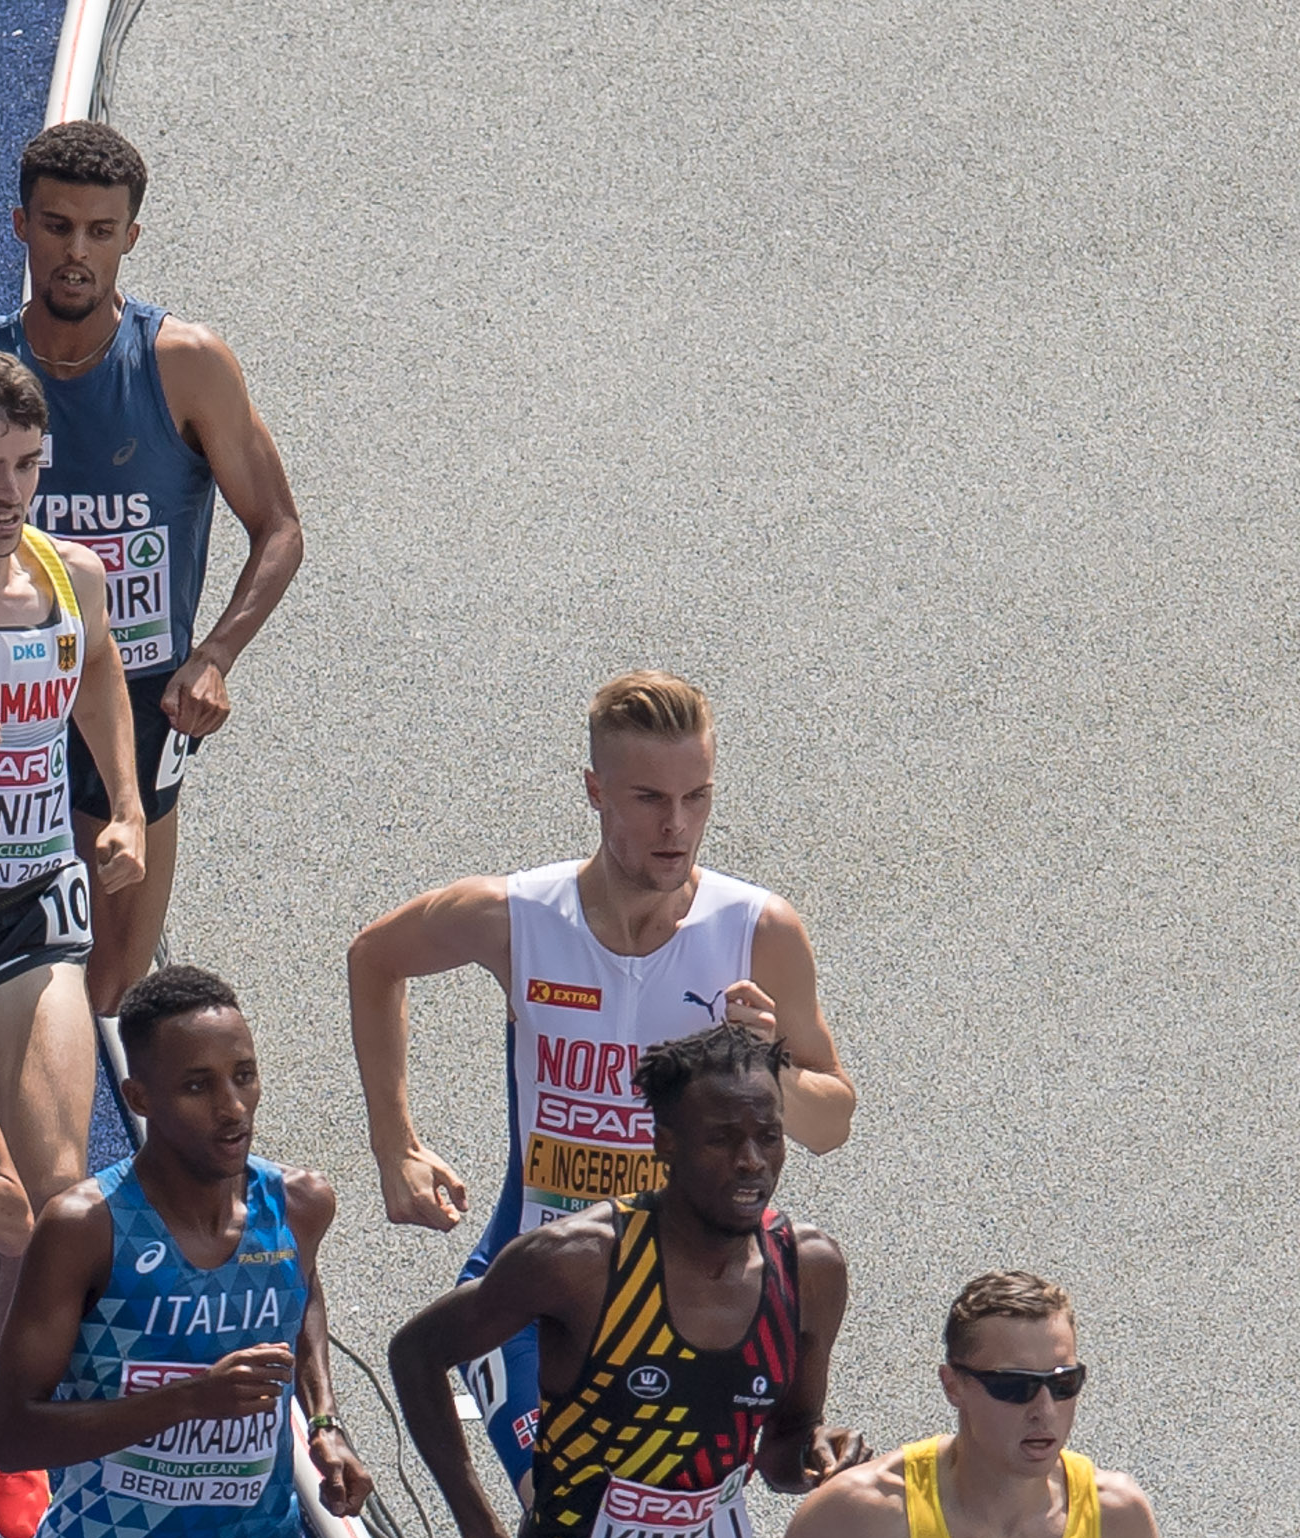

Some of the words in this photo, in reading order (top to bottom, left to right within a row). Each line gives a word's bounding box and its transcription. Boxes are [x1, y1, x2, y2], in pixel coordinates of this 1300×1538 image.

[28, 494, 151, 531] YPRUS
[13, 642, 46, 662] DKB
[120, 641, 159, 665] 018
[43, 877, 89, 936] 10
[553, 989, 598, 1005] EXTRA
[540, 1098, 655, 1138] SPAR
[529, 1140, 546, 1184] F.
[144, 1287, 280, 1336] ITALIA
[138, 1411, 276, 1455] DIKADAR
[120, 1471, 204, 1501] BERLIN
[210, 1480, 261, 1501] 2018
[157, 1462, 189, 1476] RUN
